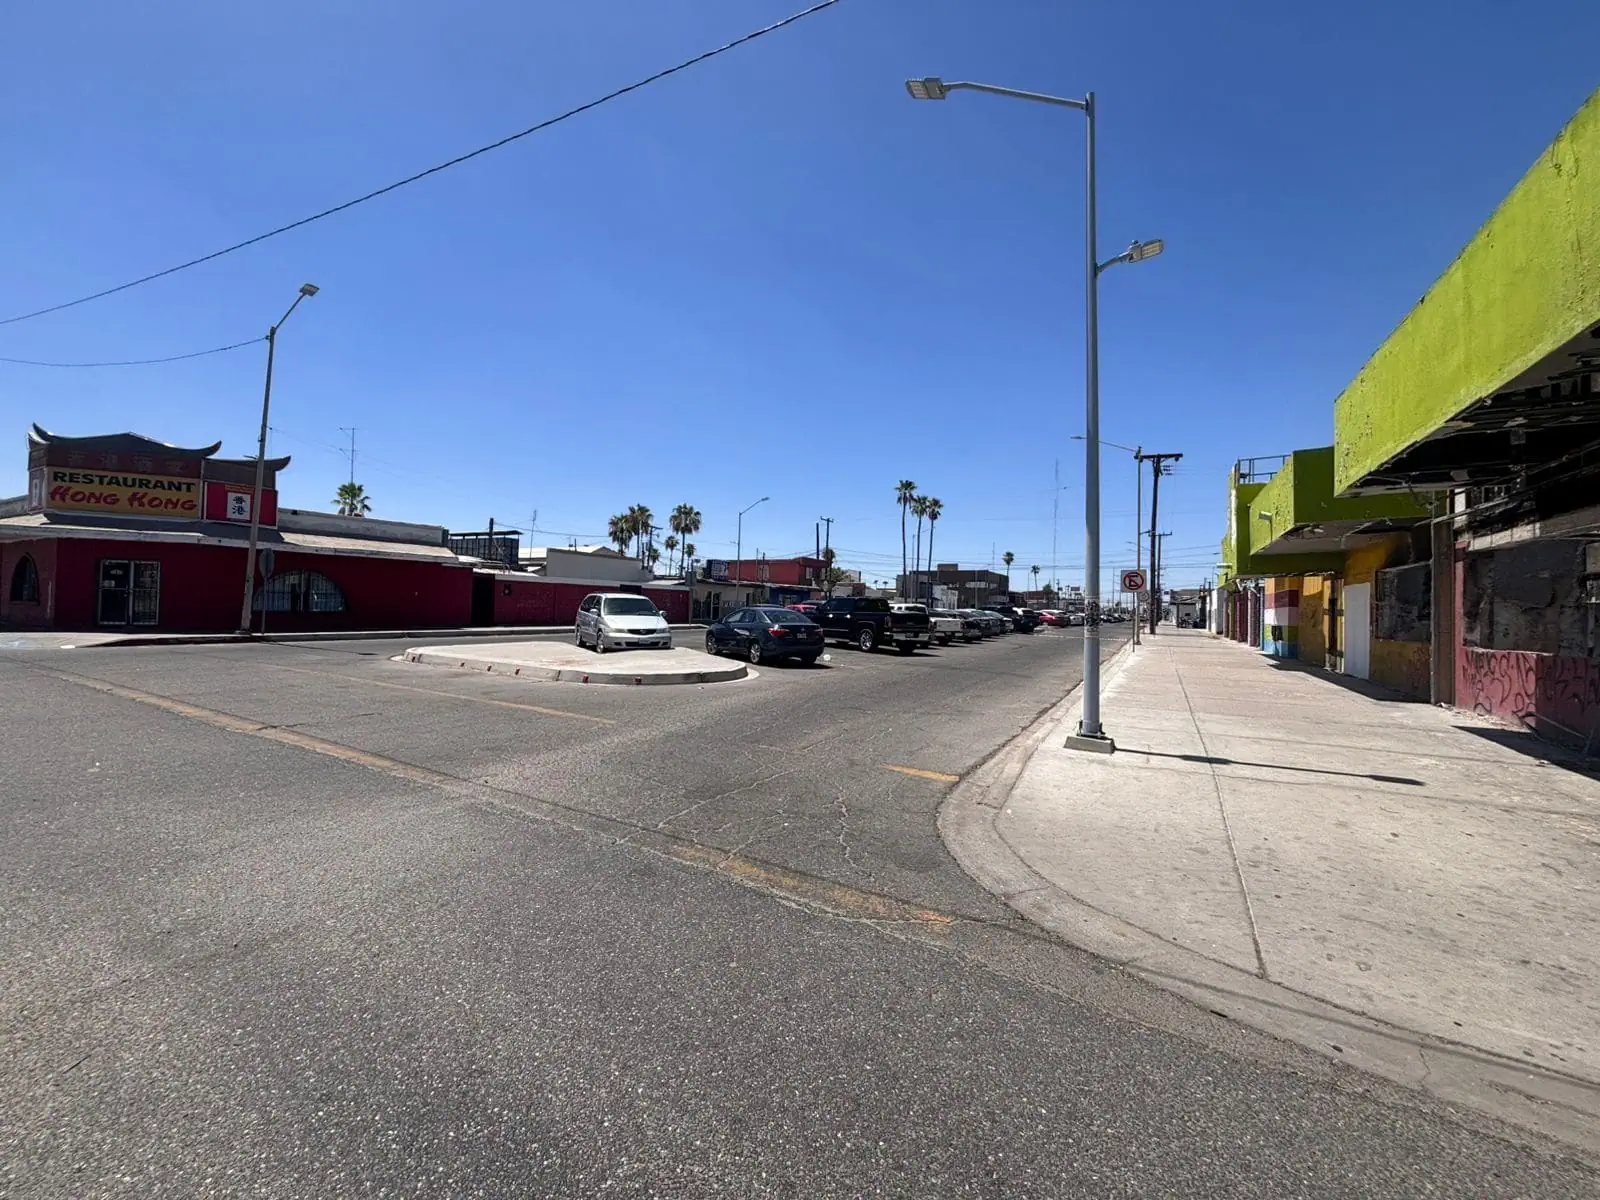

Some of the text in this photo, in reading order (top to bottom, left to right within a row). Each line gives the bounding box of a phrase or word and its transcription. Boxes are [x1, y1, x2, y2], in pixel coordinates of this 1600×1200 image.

[54, 472, 196, 492] RESTAURANT
[50, 486, 198, 511] HONG KONG
